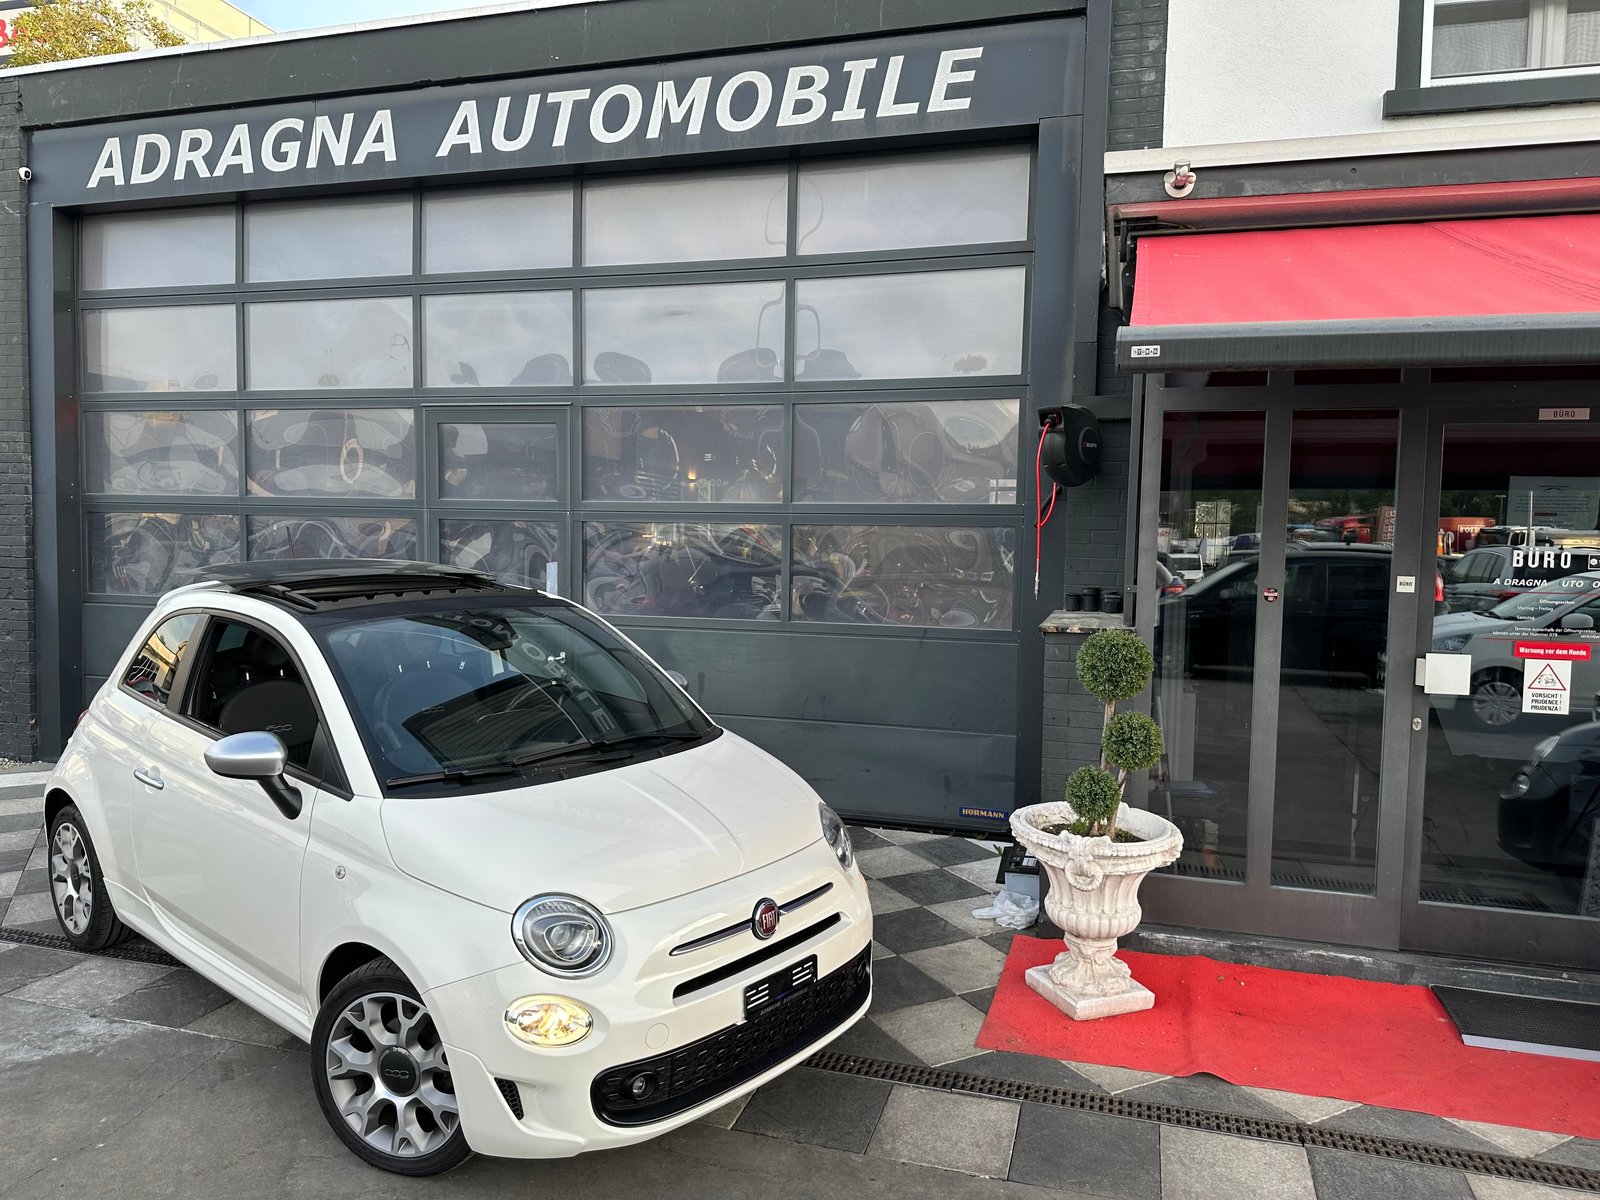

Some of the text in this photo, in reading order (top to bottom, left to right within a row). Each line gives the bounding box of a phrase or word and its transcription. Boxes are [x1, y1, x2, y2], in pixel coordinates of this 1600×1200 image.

[86, 46, 984, 189] ADRAGNA AUTOMOBILE
[1512, 548, 1572, 569] BÜRO
[1519, 646, 1544, 655] Warnung
[761, 910, 777, 930] FIAT
